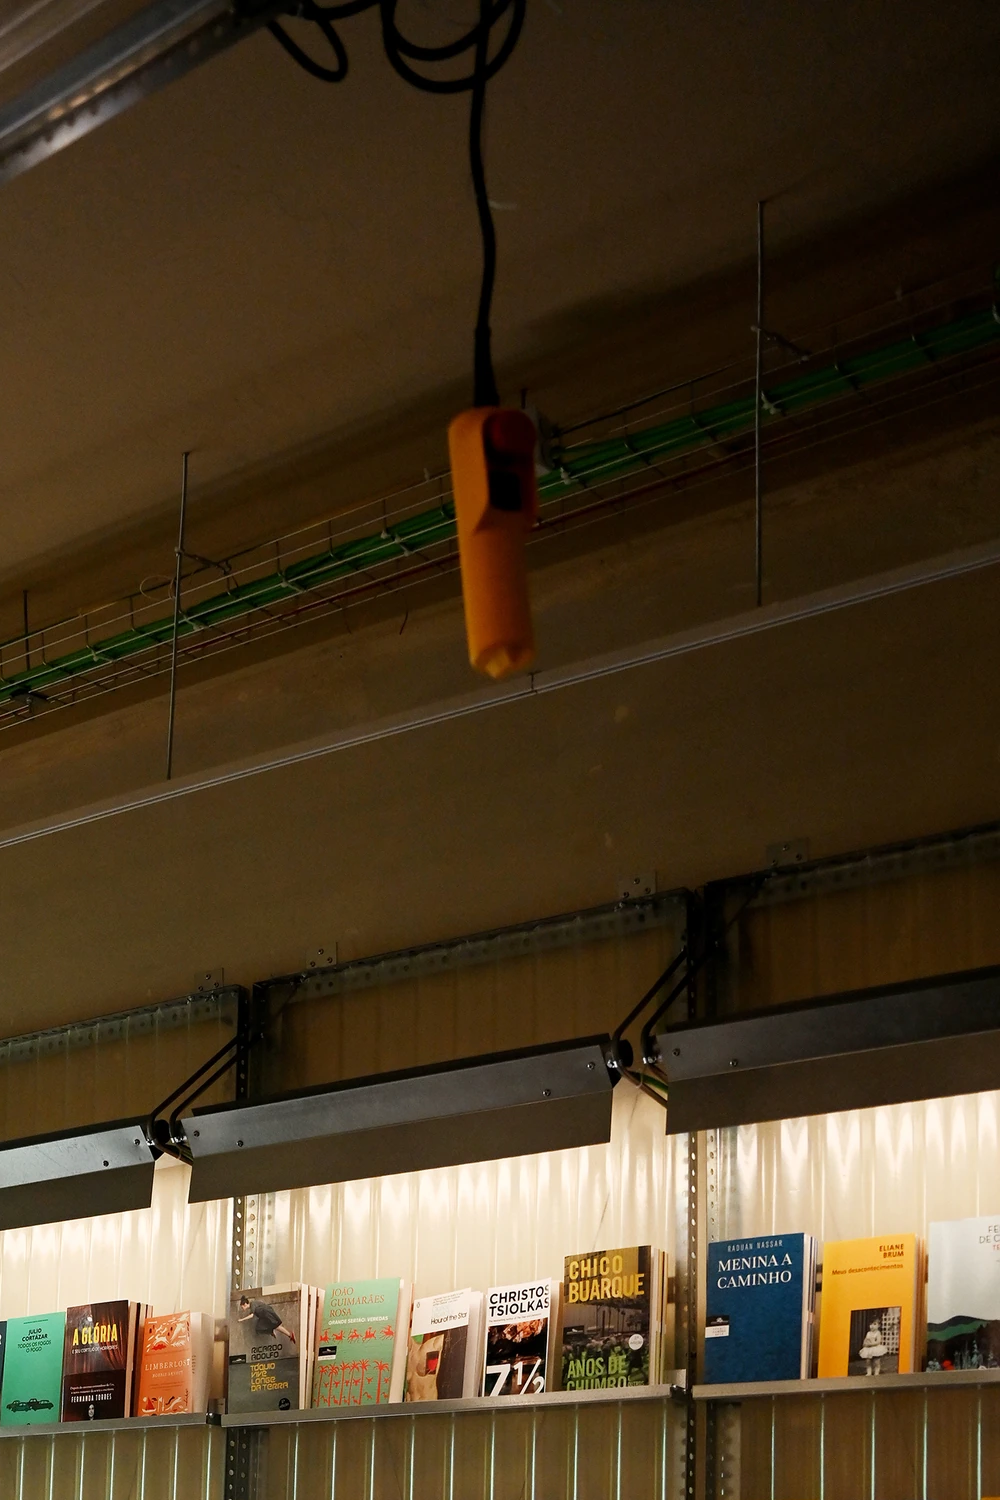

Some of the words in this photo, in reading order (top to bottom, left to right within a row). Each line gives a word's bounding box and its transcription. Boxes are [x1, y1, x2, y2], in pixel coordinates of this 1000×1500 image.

[727, 1243, 754, 1252] RADUAN
[756, 1239, 783, 1249] NASSAR
[879, 1243, 905, 1252] ELIANE
[883, 1250, 904, 1259] BRUM
[568, 1255, 623, 1280] CHICO
[717, 1255, 777, 1273] MENINA
[781, 1252, 793, 1267] A
[568, 1273, 645, 1303] BUARQUE
[716, 1269, 792, 1289] CAMINHO
[330, 1287, 354, 1299] JOÃO
[330, 1294, 385, 1308] GUIMARÃES
[489, 1284, 550, 1305] CHRISTOS
[329, 1308, 352, 1318] ROSA
[489, 1297, 550, 1318] TSIOLKAS
[72, 1328, 79, 1346] A
[81, 1322, 118, 1345] GLÓRIA
[567, 1357, 604, 1379] ANOS
[608, 1355, 627, 1375] DE
